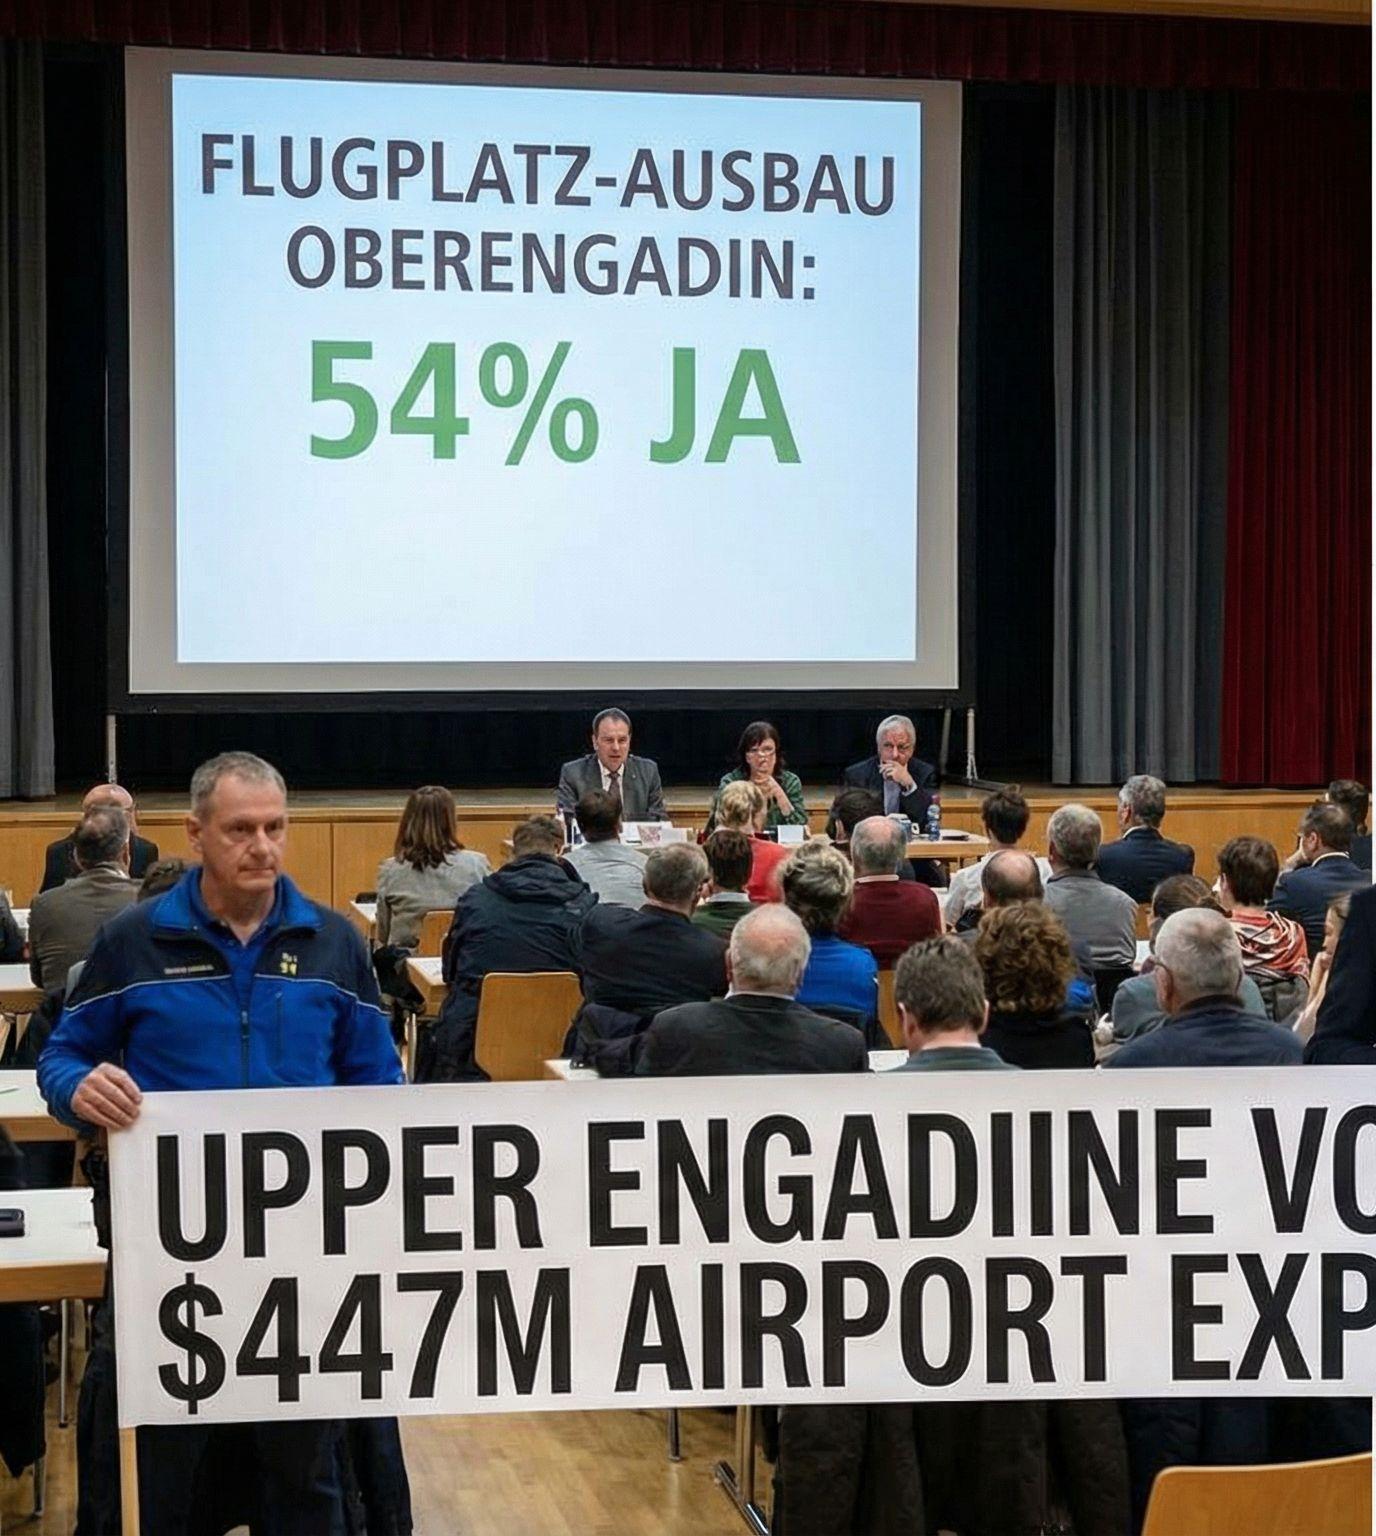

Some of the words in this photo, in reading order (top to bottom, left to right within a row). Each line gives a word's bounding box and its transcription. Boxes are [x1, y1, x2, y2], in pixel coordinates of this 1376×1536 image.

[201, 133, 895, 217] FLUGPLATZ-AUSBAU
[286, 225, 815, 300] OBERENGADIN:
[310, 339, 599, 466] 54%
[649, 347, 802, 464] JA
[156, 1124, 544, 1262] UPPER
[587, 1107, 1214, 1247] ENGADIINE
[156, 1267, 572, 1415] $447M
[614, 1255, 1128, 1392] AIRPORT
